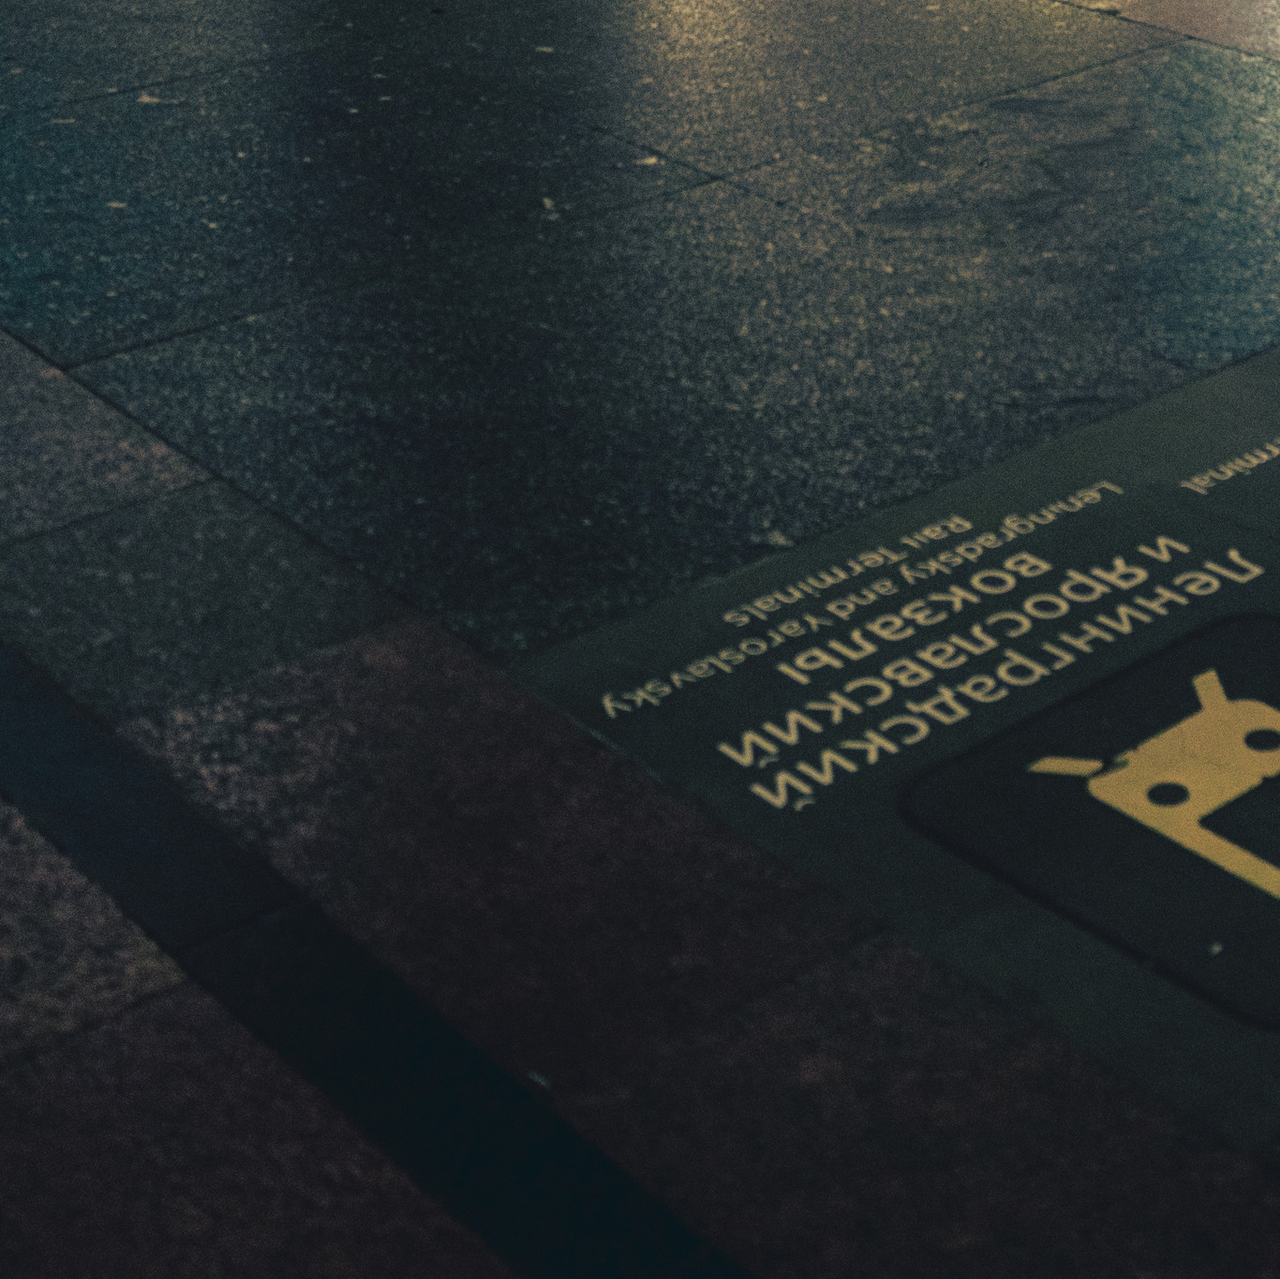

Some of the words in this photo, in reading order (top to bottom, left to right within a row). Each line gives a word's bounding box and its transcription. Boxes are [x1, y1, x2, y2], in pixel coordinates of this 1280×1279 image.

[898, 480, 1123, 584] Leningradsky
[899, 512, 972, 549] Rail
[1137, 534, 1189, 569] и
[721, 544, 907, 628] Terminals
[775, 550, 1051, 684] вокзалы
[824, 577, 898, 619] and
[600, 614, 832, 718] Yaroslavsky
[715, 554, 1149, 768] Ярославский
[748, 548, 1263, 810] Ленинградский
